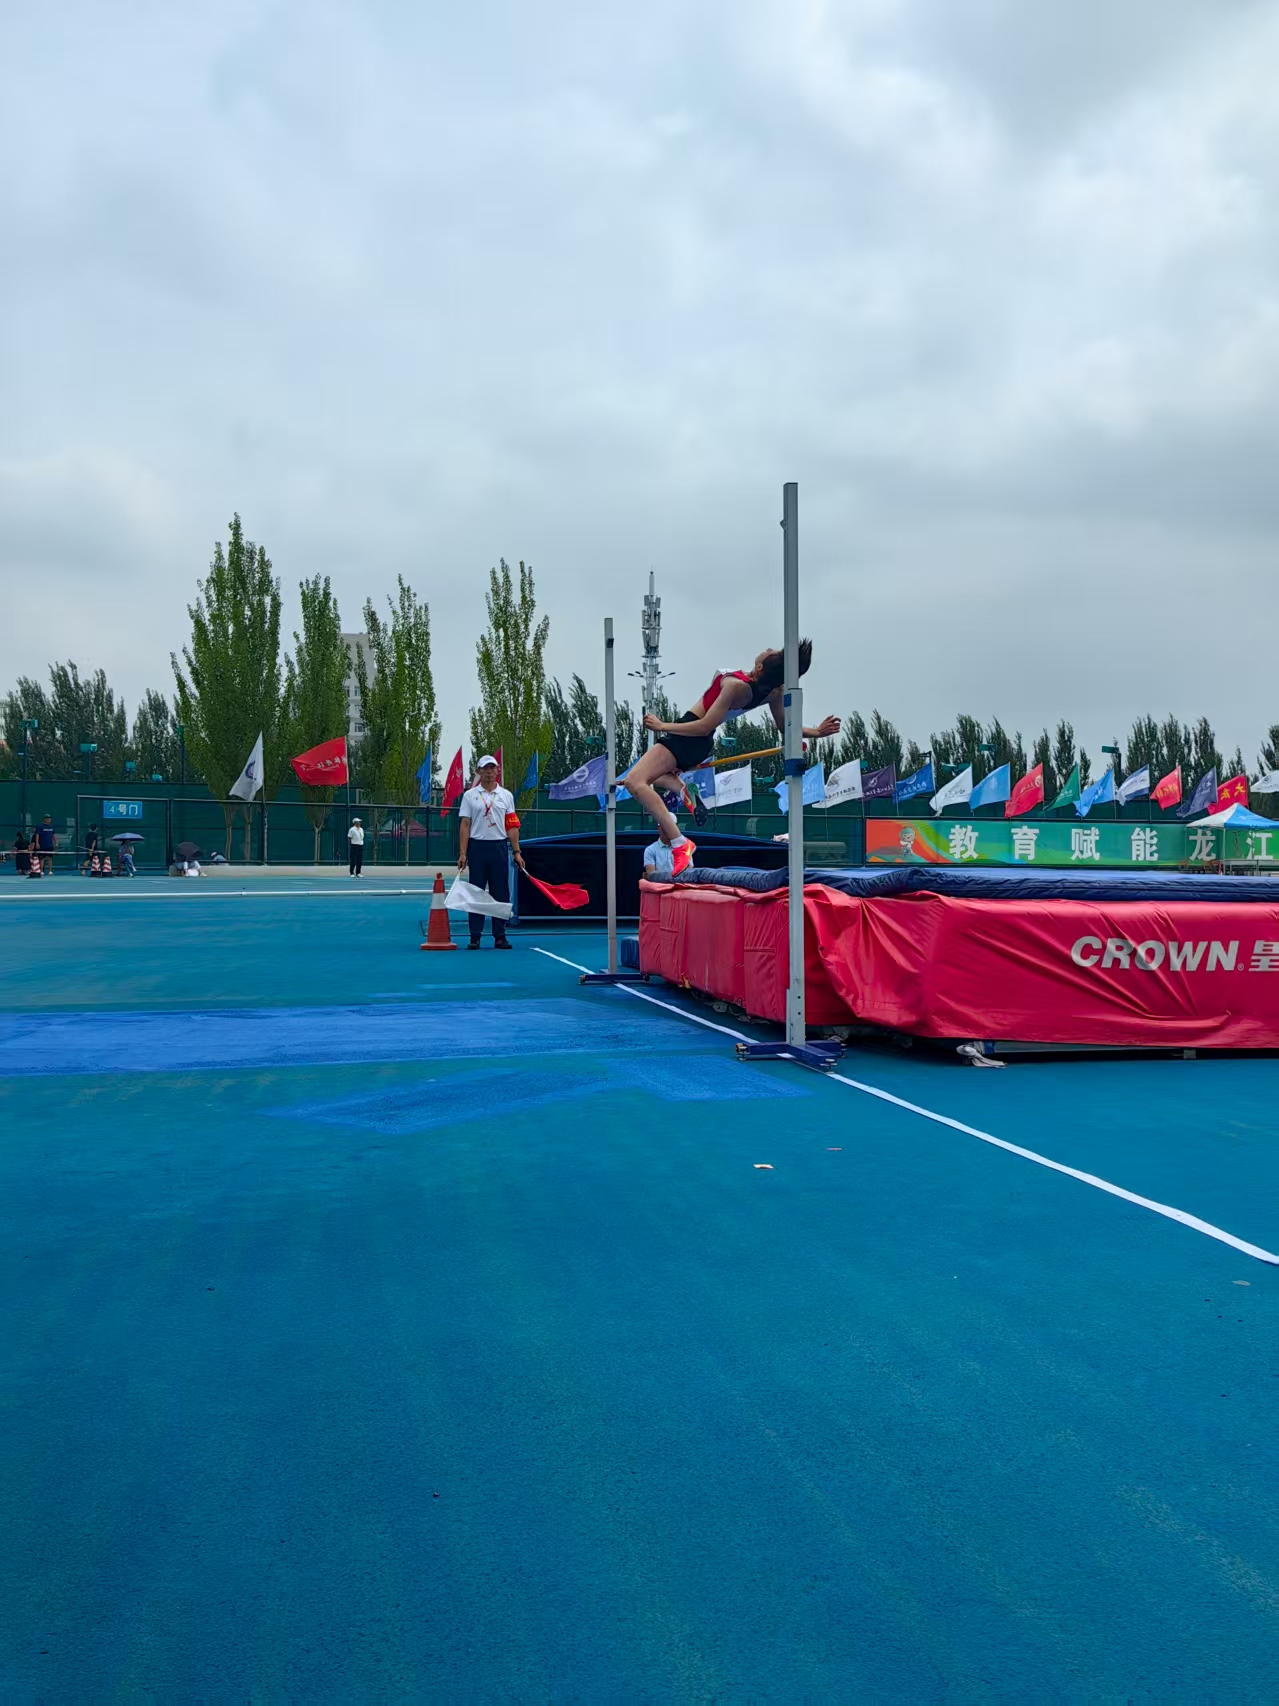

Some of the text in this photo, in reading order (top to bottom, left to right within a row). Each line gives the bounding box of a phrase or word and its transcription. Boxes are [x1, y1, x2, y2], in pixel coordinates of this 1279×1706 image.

[949, 825, 1274, 862] 教育赋能龙江
[1070, 936, 1239, 972] CROWN
